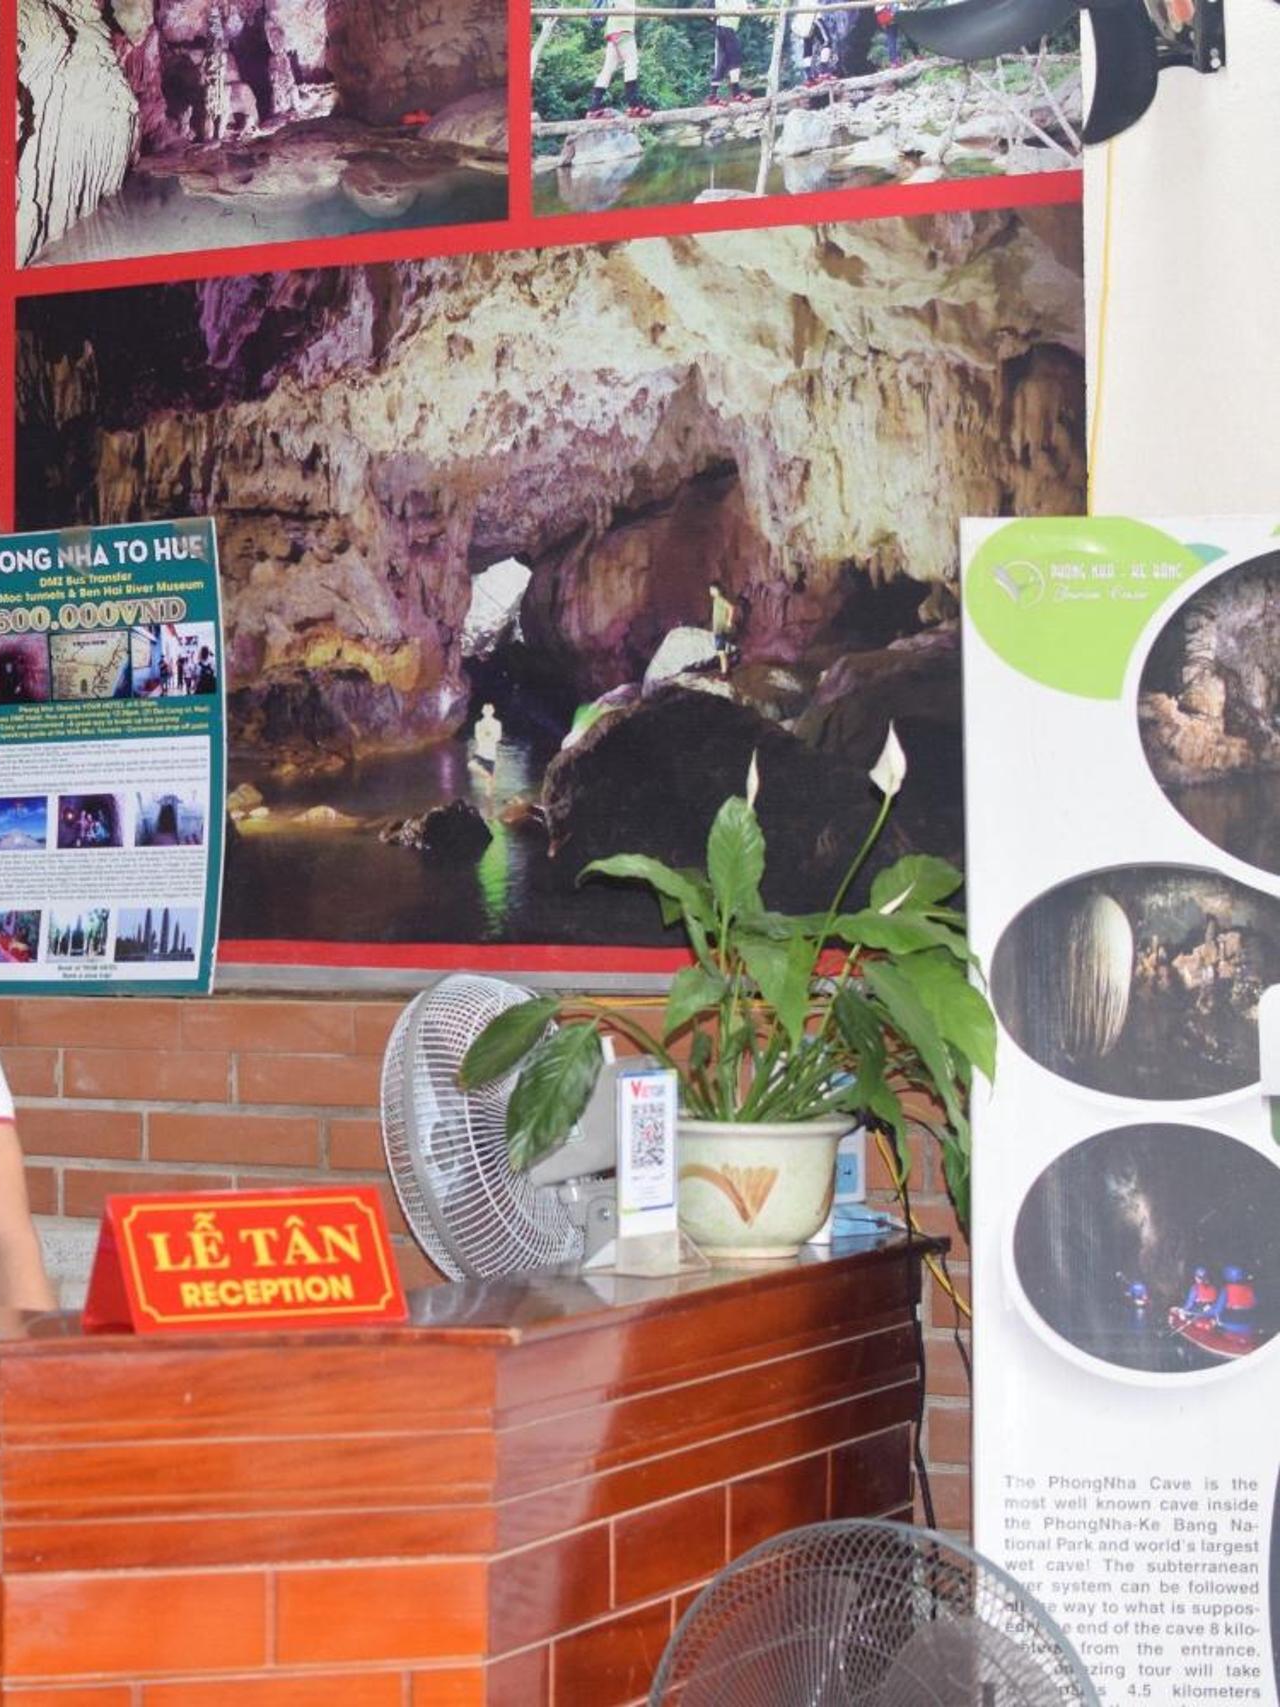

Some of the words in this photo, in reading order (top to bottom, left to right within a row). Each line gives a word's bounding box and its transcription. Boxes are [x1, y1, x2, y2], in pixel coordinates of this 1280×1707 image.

[58, 543, 110, 568] NHA
[114, 539, 148, 565] TO
[154, 535, 203, 562] HUE
[66, 575, 86, 586] Bus
[89, 572, 133, 584] Transfer
[0, 593, 22, 604] Moc
[69, 588, 77, 599] &
[80, 587, 101, 598] Ben
[103, 585, 123, 597] Hai
[125, 582, 154, 595] River
[156, 580, 204, 592] Museum
[147, 1211, 231, 1272] LỄ
[239, 1215, 362, 1268] TÂN
[180, 1274, 354, 1308] RECEPTION
[1004, 1475, 1036, 1489] The
[1048, 1476, 1137, 1493] PhongNha
[1149, 1476, 1192, 1491] Cave
[1204, 1477, 1219, 1491] is
[1231, 1477, 1258, 1491] the
[1004, 1497, 1046, 1510] most
[1054, 1496, 1087, 1510] well
[1096, 1496, 1151, 1511] known
[1160, 1500, 1199, 1512] cave
[1207, 1498, 1259, 1512] inside
[1004, 1517, 1031, 1530] the
[1043, 1517, 1161, 1535] PhongNha-Ke
[1173, 1518, 1218, 1535] Bang
[1230, 1519, 1259, 1533] Na-
[1004, 1537, 1051, 1551] tional
[1056, 1537, 1093, 1551] Park
[1098, 1539, 1129, 1552] and
[1134, 1538, 1196, 1553] world's
[1201, 1539, 1259, 1555] largest
[1005, 1559, 1035, 1571] wet
[1104, 1559, 1134, 1573] The
[1147, 1560, 1259, 1574] subterranean
[1052, 1580, 1112, 1596] system
[1120, 1582, 1150, 1593] can
[1160, 1581, 1180, 1594] be
[1188, 1581, 1259, 1595] followed
[1064, 1603, 1095, 1617] way
[1102, 1602, 1119, 1614] to
[1125, 1601, 1165, 1614] what
[1172, 1602, 1185, 1615] is
[1191, 1604, 1260, 1619] suppos-
[1076, 1621, 1108, 1635] end
[1113, 1621, 1129, 1635] of
[1134, 1621, 1161, 1635] the
[1165, 1624, 1204, 1635] cave
[1224, 1621, 1260, 1636] kilo-
[1081, 1642, 1119, 1655] from
[1137, 1643, 1163, 1656] the
[1181, 1644, 1260, 1658] entrance.
[1138, 1664, 1171, 1677] tour
[1184, 1663, 1213, 1677] will
[1226, 1664, 1260, 1678] take
[1127, 1684, 1152, 1697] 4.5
[1172, 1684, 1260, 1699] kilometers
